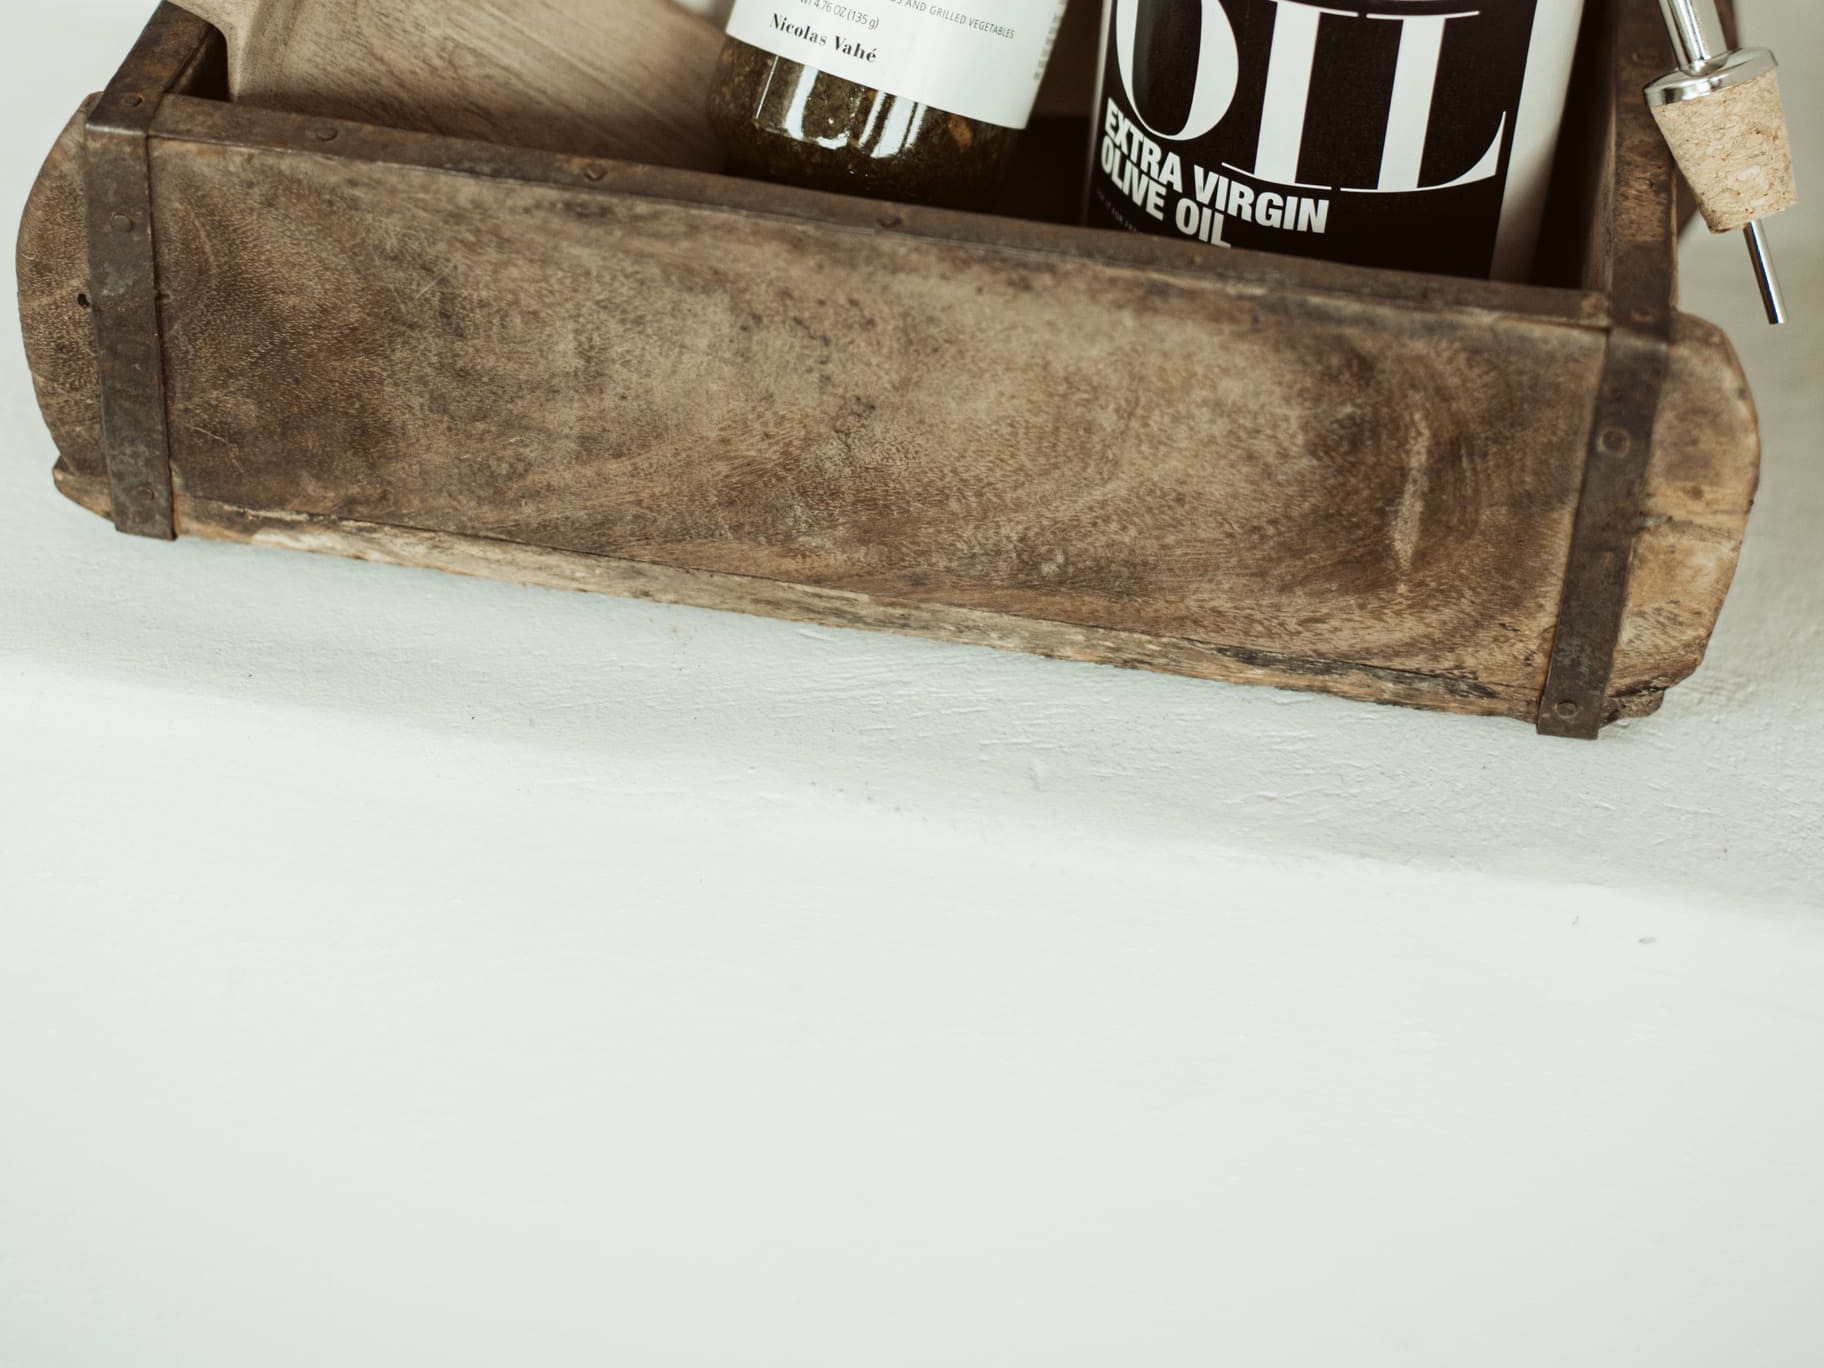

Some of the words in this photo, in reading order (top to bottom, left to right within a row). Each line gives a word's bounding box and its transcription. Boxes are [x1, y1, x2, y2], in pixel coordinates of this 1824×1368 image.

[769, 12, 829, 46] Nicolas
[834, 35, 878, 63] Vahé
[833, 4, 848, 18] OZ
[846, 8, 869, 26] (135
[868, 17, 880, 31] g)
[928, 5, 967, 25] GRILLED
[1104, 96, 1184, 194] EXTRA
[1193, 163, 1330, 234] VIRGIN
[1100, 135, 1168, 222] OLIVE
[1174, 197, 1232, 249] OIL
